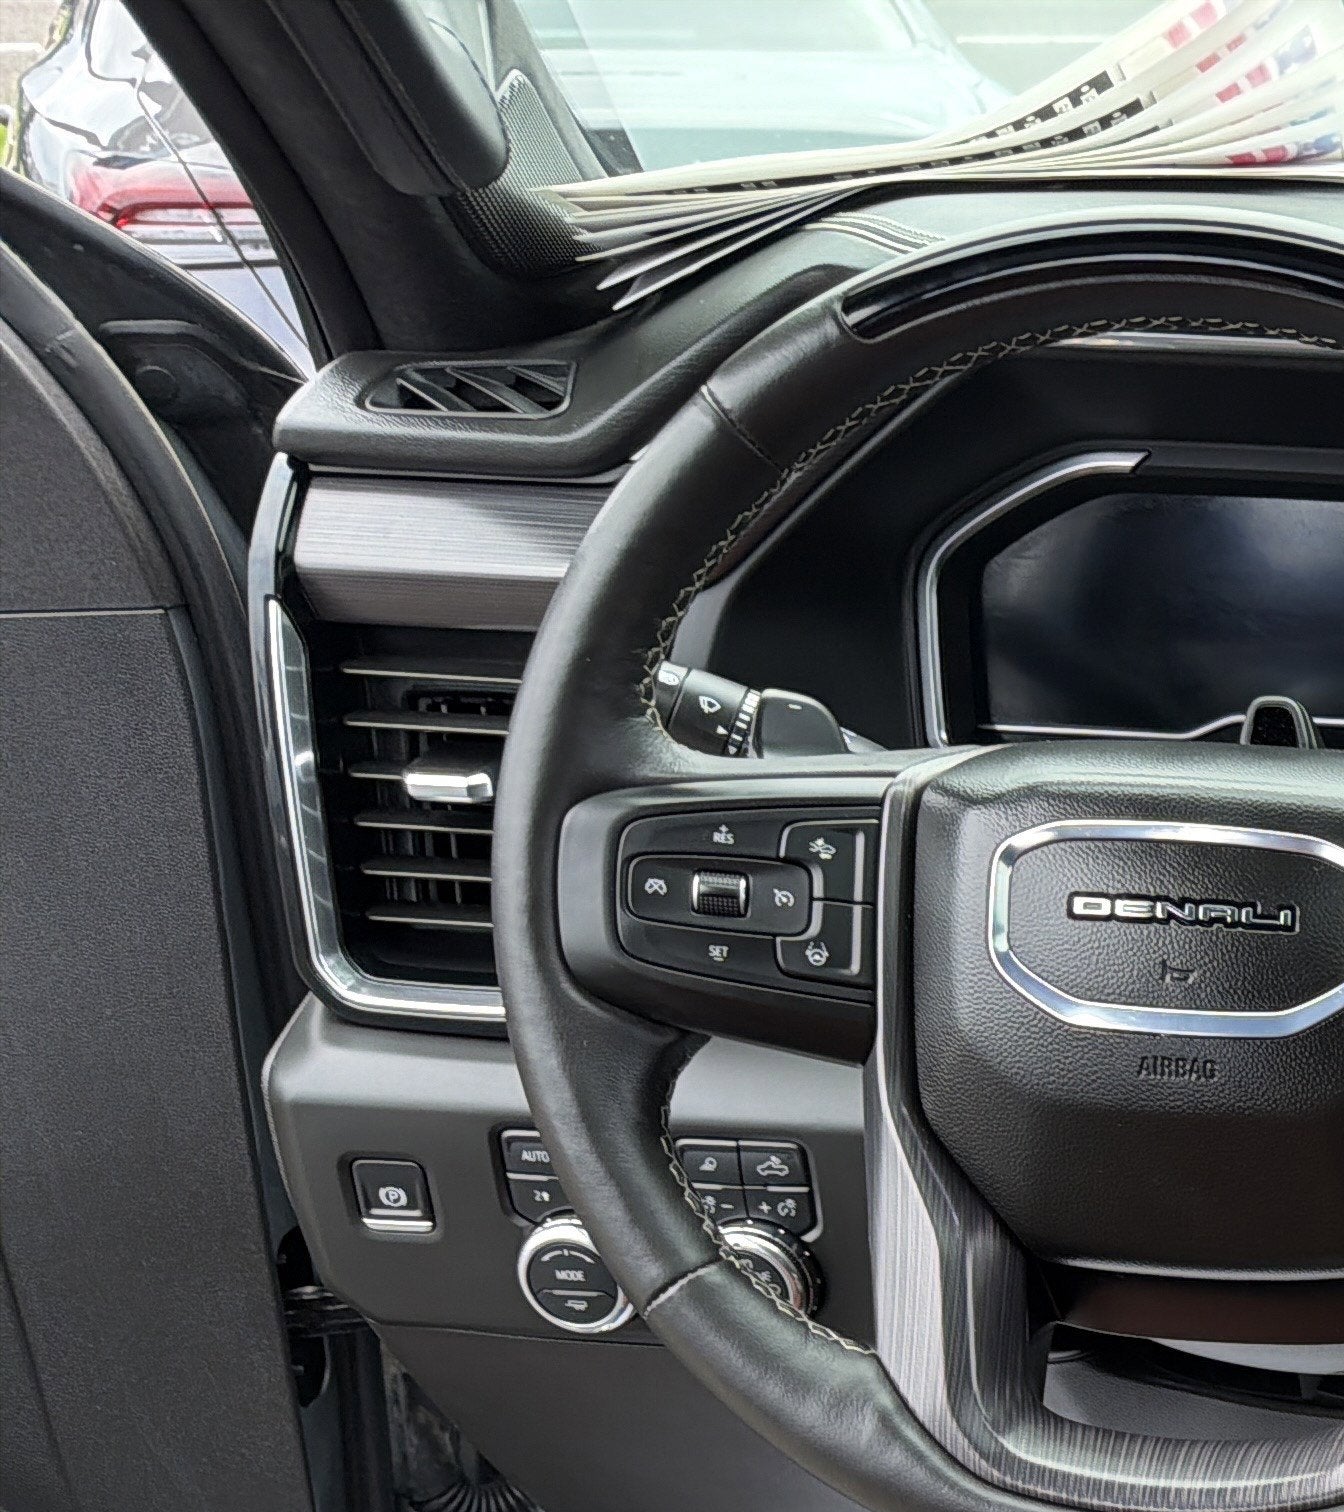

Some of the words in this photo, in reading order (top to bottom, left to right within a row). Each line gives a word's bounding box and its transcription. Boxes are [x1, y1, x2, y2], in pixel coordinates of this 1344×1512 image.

[1070, 894, 1296, 933] DENALI
[708, 944, 730, 958] SET
[1137, 1056, 1217, 1082] AIRBAG
[521, 1149, 550, 1163] AUTO
[555, 1269, 586, 1283] MODE
